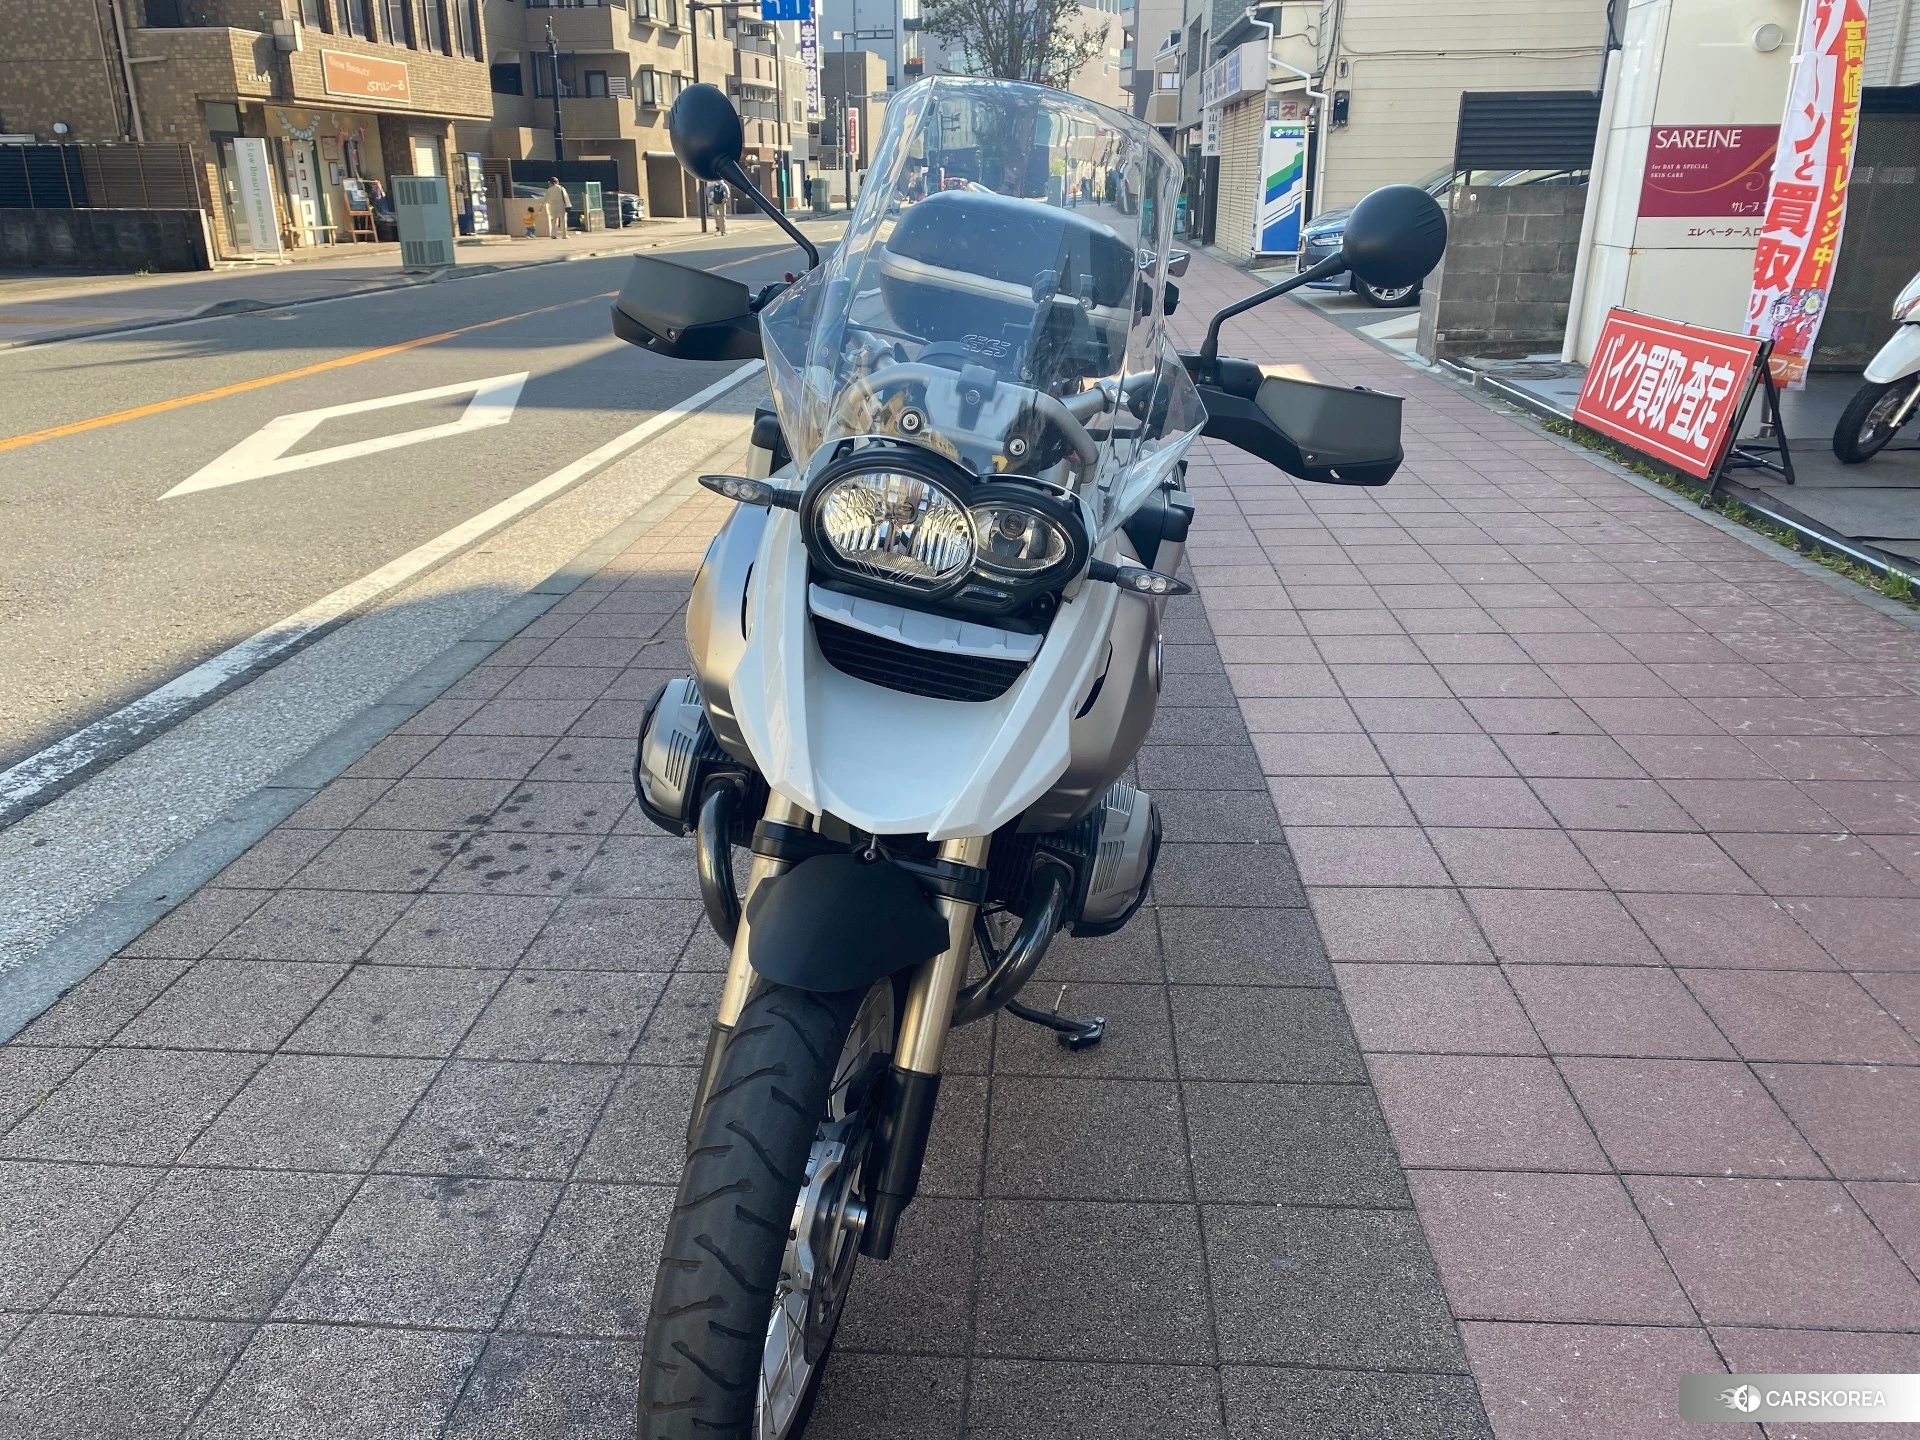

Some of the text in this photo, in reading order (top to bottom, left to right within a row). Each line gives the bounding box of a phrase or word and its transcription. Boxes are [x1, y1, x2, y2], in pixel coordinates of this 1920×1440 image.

[328, 56, 370, 77] Slow Beauty
[1655, 129, 1743, 149] SAREINE
[1811, 19, 1866, 288] 高値チャレンジ中！
[246, 142, 261, 198] Slow Beauty
[1687, 227, 1763, 237] エレベーター入口
[960, 334, 1011, 358] GS
[1587, 333, 1736, 450] バイク買取・査定
